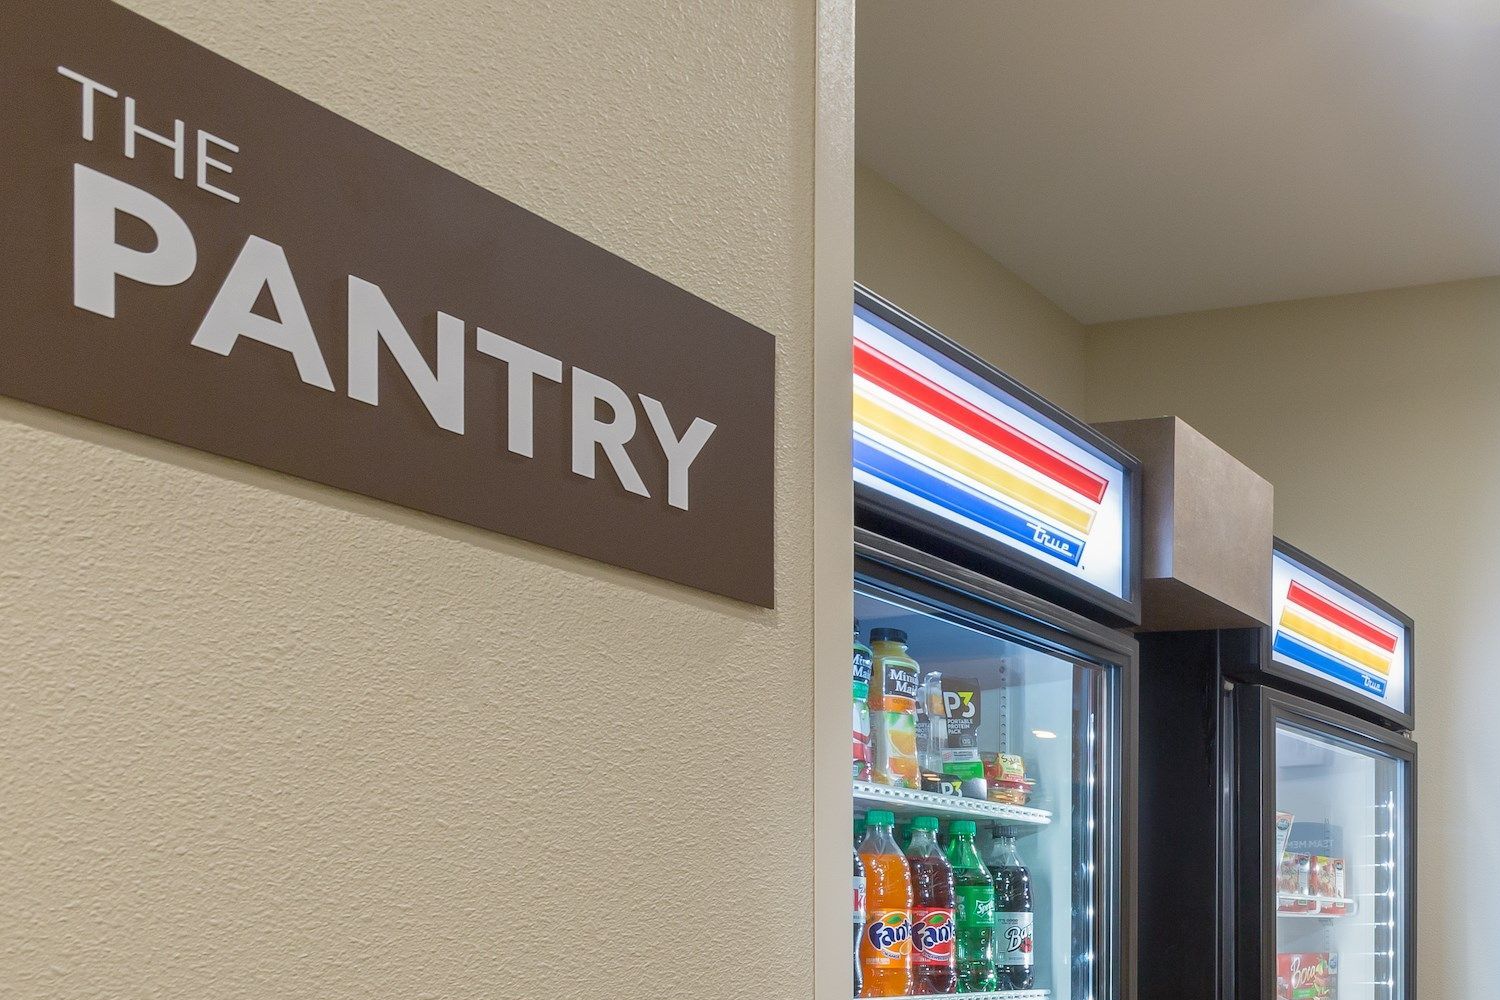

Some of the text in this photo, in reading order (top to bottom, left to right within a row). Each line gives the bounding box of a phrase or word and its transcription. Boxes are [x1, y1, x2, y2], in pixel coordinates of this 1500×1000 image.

[57, 66, 240, 203] THE
[73, 162, 718, 512] PANTRY
[942, 691, 976, 718] P3
[868, 919, 913, 951] Fant
[912, 919, 955, 952] Fant
